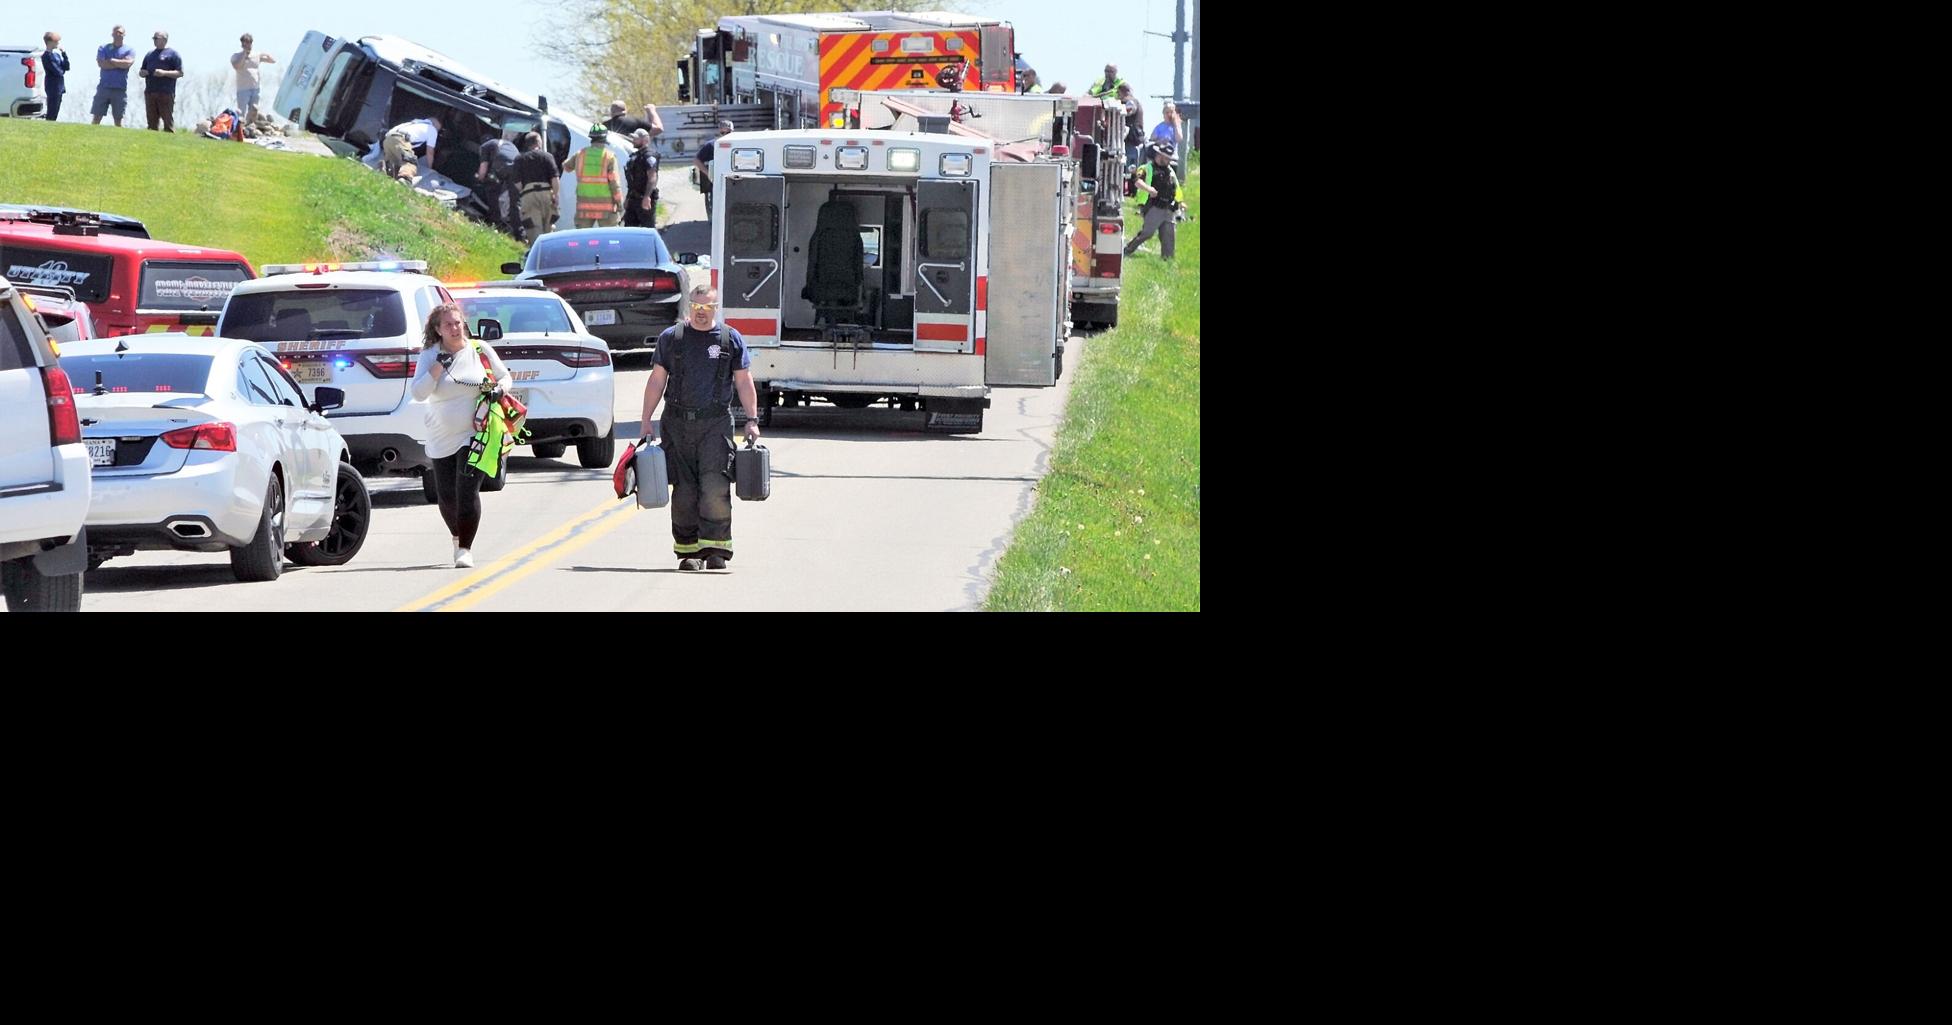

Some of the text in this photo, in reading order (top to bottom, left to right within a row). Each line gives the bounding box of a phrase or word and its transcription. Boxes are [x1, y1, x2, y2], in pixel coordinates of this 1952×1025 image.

[747, 46, 804, 76] RESCUE
[6, 264, 91, 285] UTILITY
[277, 340, 347, 353] SHERIFF
[510, 370, 540, 381] RIFF
[88, 445, 111, 458] 8216
